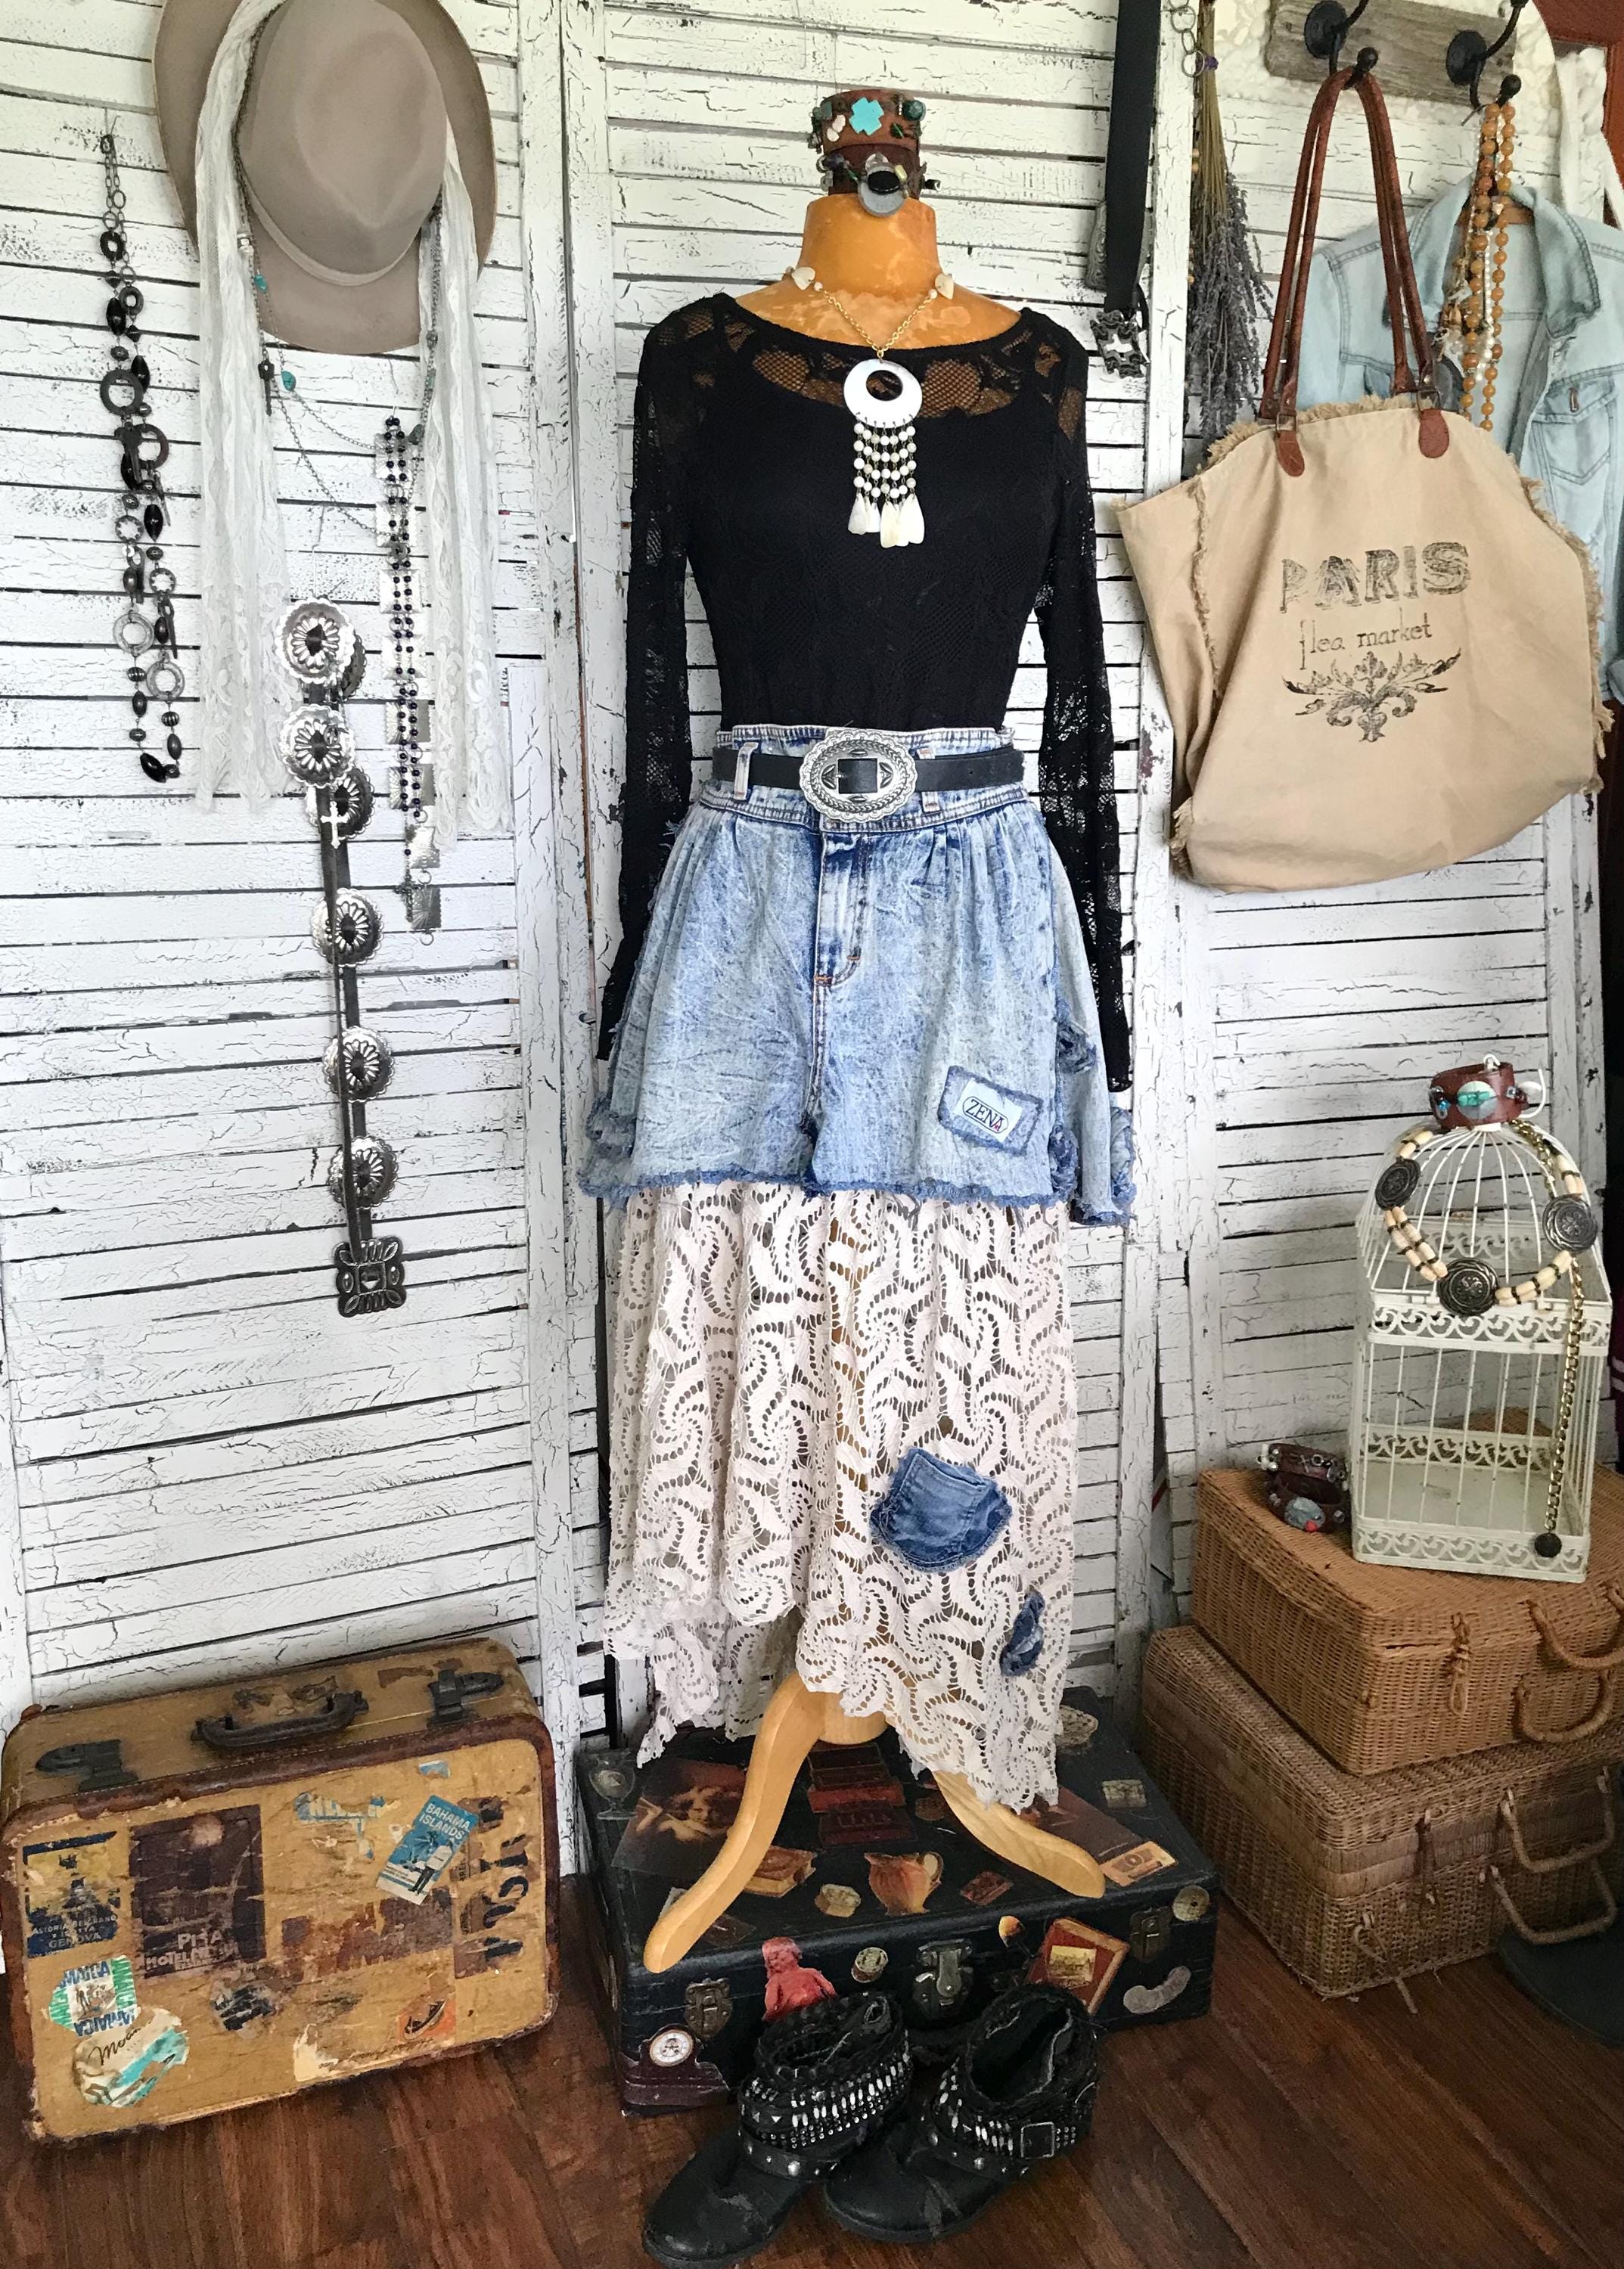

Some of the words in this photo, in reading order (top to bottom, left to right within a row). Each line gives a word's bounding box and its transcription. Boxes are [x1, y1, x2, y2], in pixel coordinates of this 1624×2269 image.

[1280, 542, 1470, 613] PARIS
[1299, 619, 1346, 670] flea
[1357, 607, 1433, 648] market
[965, 1098, 1005, 1132] ZENA
[419, 1814, 465, 1839] ISLANDS
[425, 1802, 471, 1833] BAHAMA
[32, 1924, 67, 1935] ASTORIA
